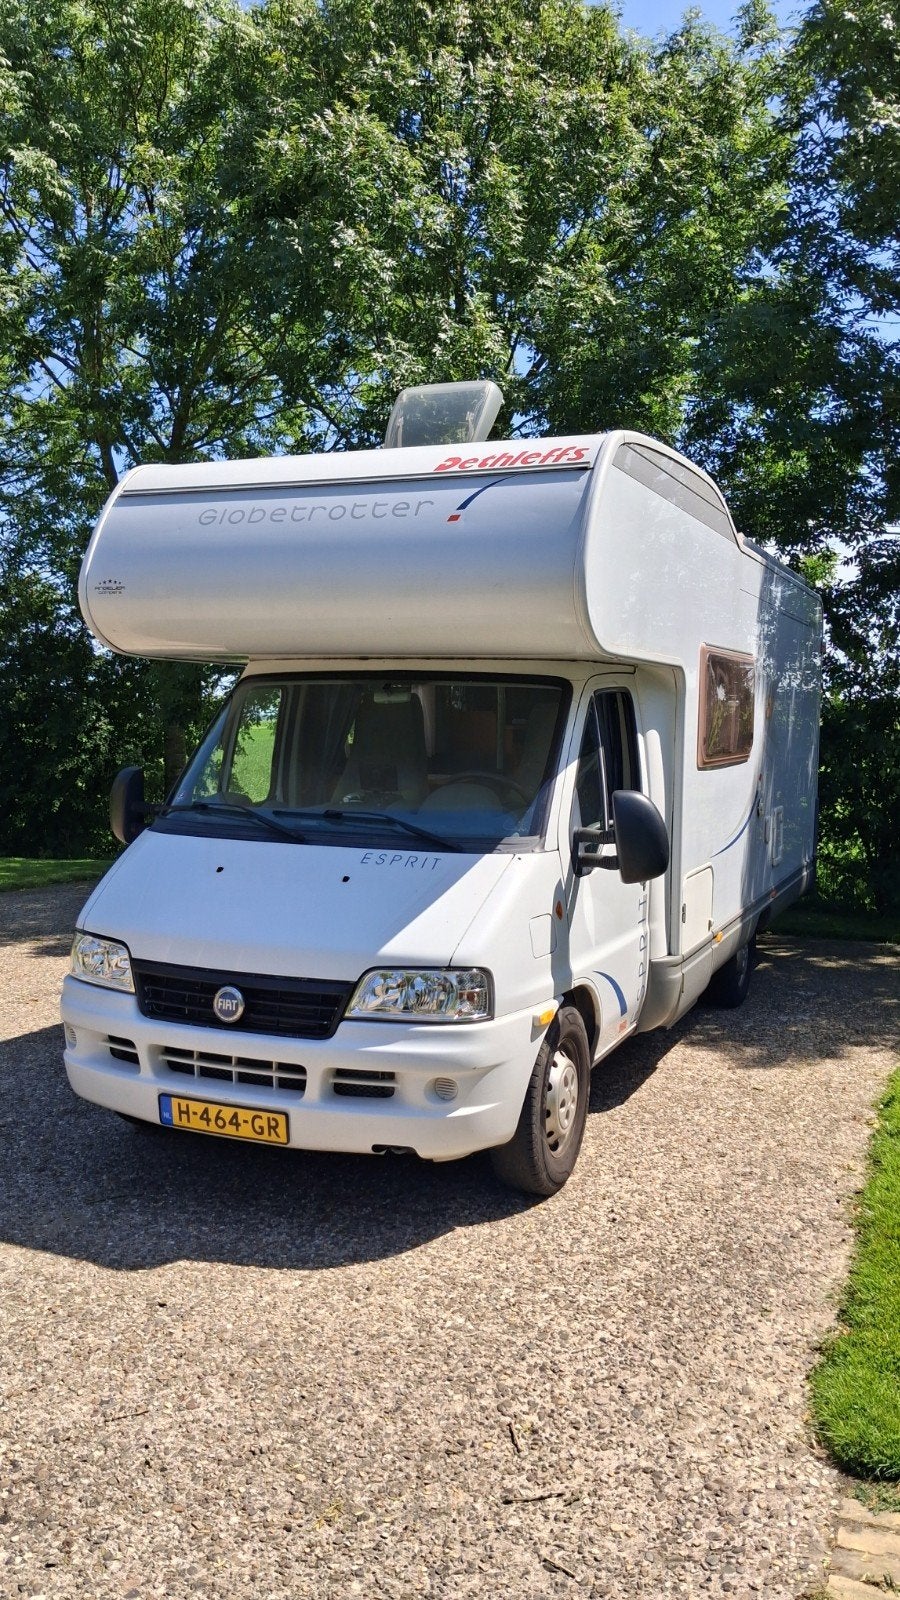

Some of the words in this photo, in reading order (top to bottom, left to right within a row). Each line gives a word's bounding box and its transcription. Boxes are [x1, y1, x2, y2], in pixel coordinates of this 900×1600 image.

[434, 446, 590, 472] Dethleffs
[198, 500, 434, 527] Globetrotter
[360, 852, 442, 870] ESPRIT
[217, 998, 238, 1011] FIAT
[177, 1101, 281, 1139] H-464-GR
